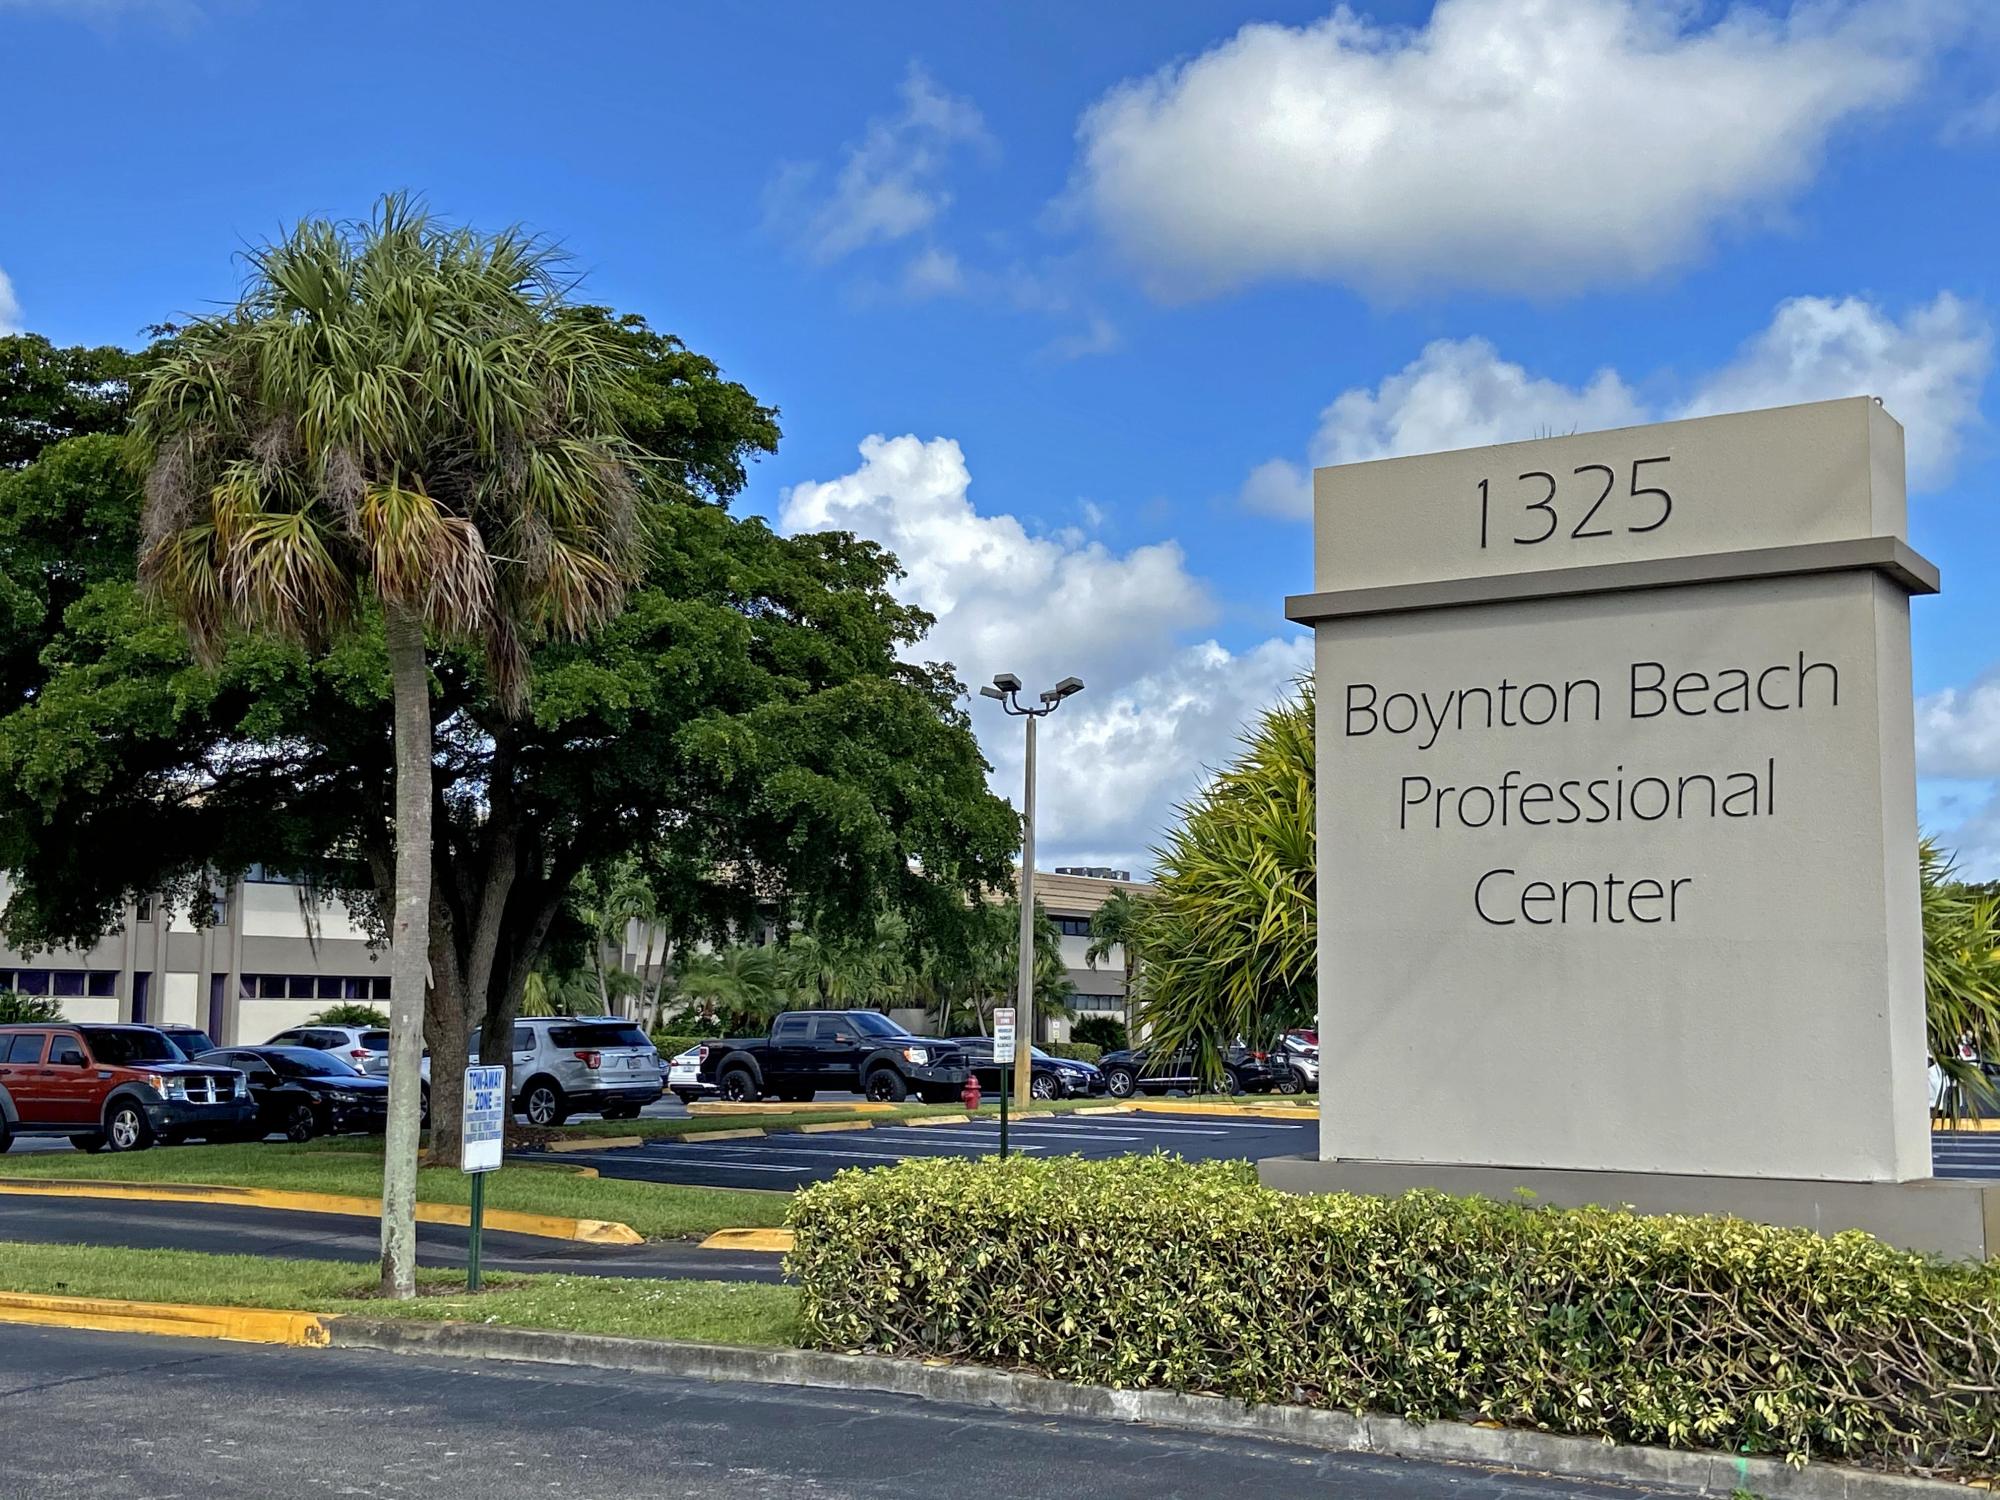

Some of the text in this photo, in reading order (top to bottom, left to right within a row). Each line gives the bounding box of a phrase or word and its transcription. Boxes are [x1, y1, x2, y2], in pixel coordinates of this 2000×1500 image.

[1476, 455, 1673, 549] 1325
[1345, 650, 1839, 750] Boynton Beach
[1400, 757, 1775, 830] Professional
[1474, 868, 1692, 926] Center
[469, 1070, 502, 1091] TOW-AWAY
[475, 1091, 492, 1110] ZONE
